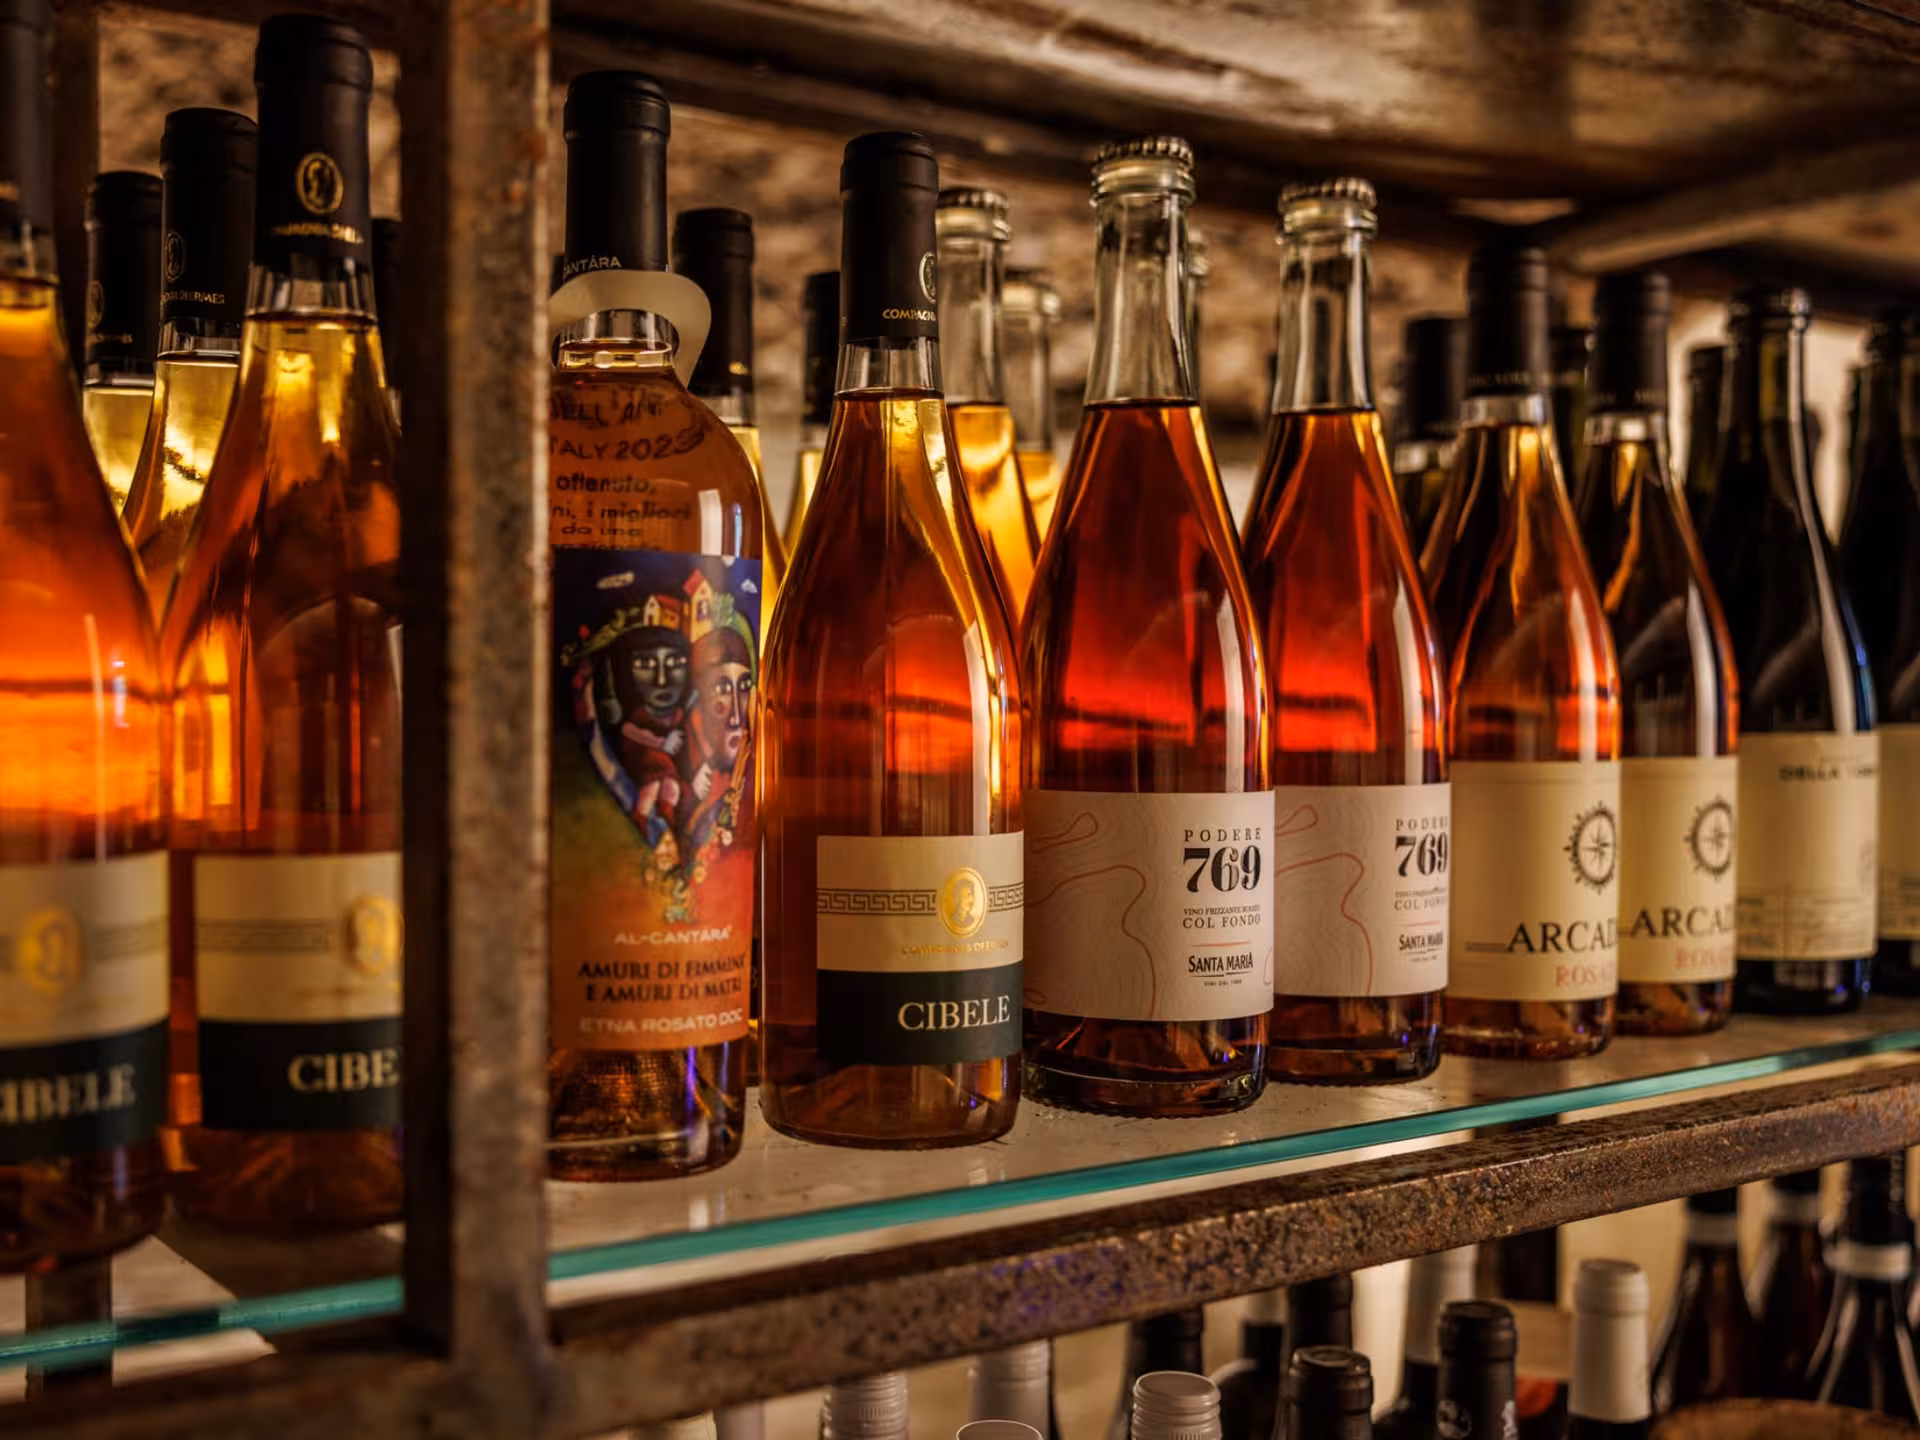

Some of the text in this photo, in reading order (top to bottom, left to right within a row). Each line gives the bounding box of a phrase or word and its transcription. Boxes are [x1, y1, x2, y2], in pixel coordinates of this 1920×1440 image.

[1184, 827, 1262, 842] PODERE
[1395, 832, 1448, 877] 769
[1183, 844, 1261, 893] 769
[1184, 908, 1203, 916] VINO
[1205, 905, 1241, 915] FRIZZANTE
[1394, 899, 1419, 911] COL
[1183, 913, 1261, 929] COL FONDO
[1399, 934, 1426, 951] SANTA
[578, 960, 649, 979] AMURI
[658, 961, 680, 978] DI
[1188, 951, 1254, 973] SANTA MARIA
[586, 984, 596, 1001] E
[602, 983, 673, 1002] AMURI
[680, 983, 699, 1000] DI
[580, 1008, 743, 1033] ETNA ROSATO DOC
[898, 995, 1010, 1031] CIBELE
[287, 1048, 400, 1094] CIBE
[0, 1062, 137, 1125] IBELE
